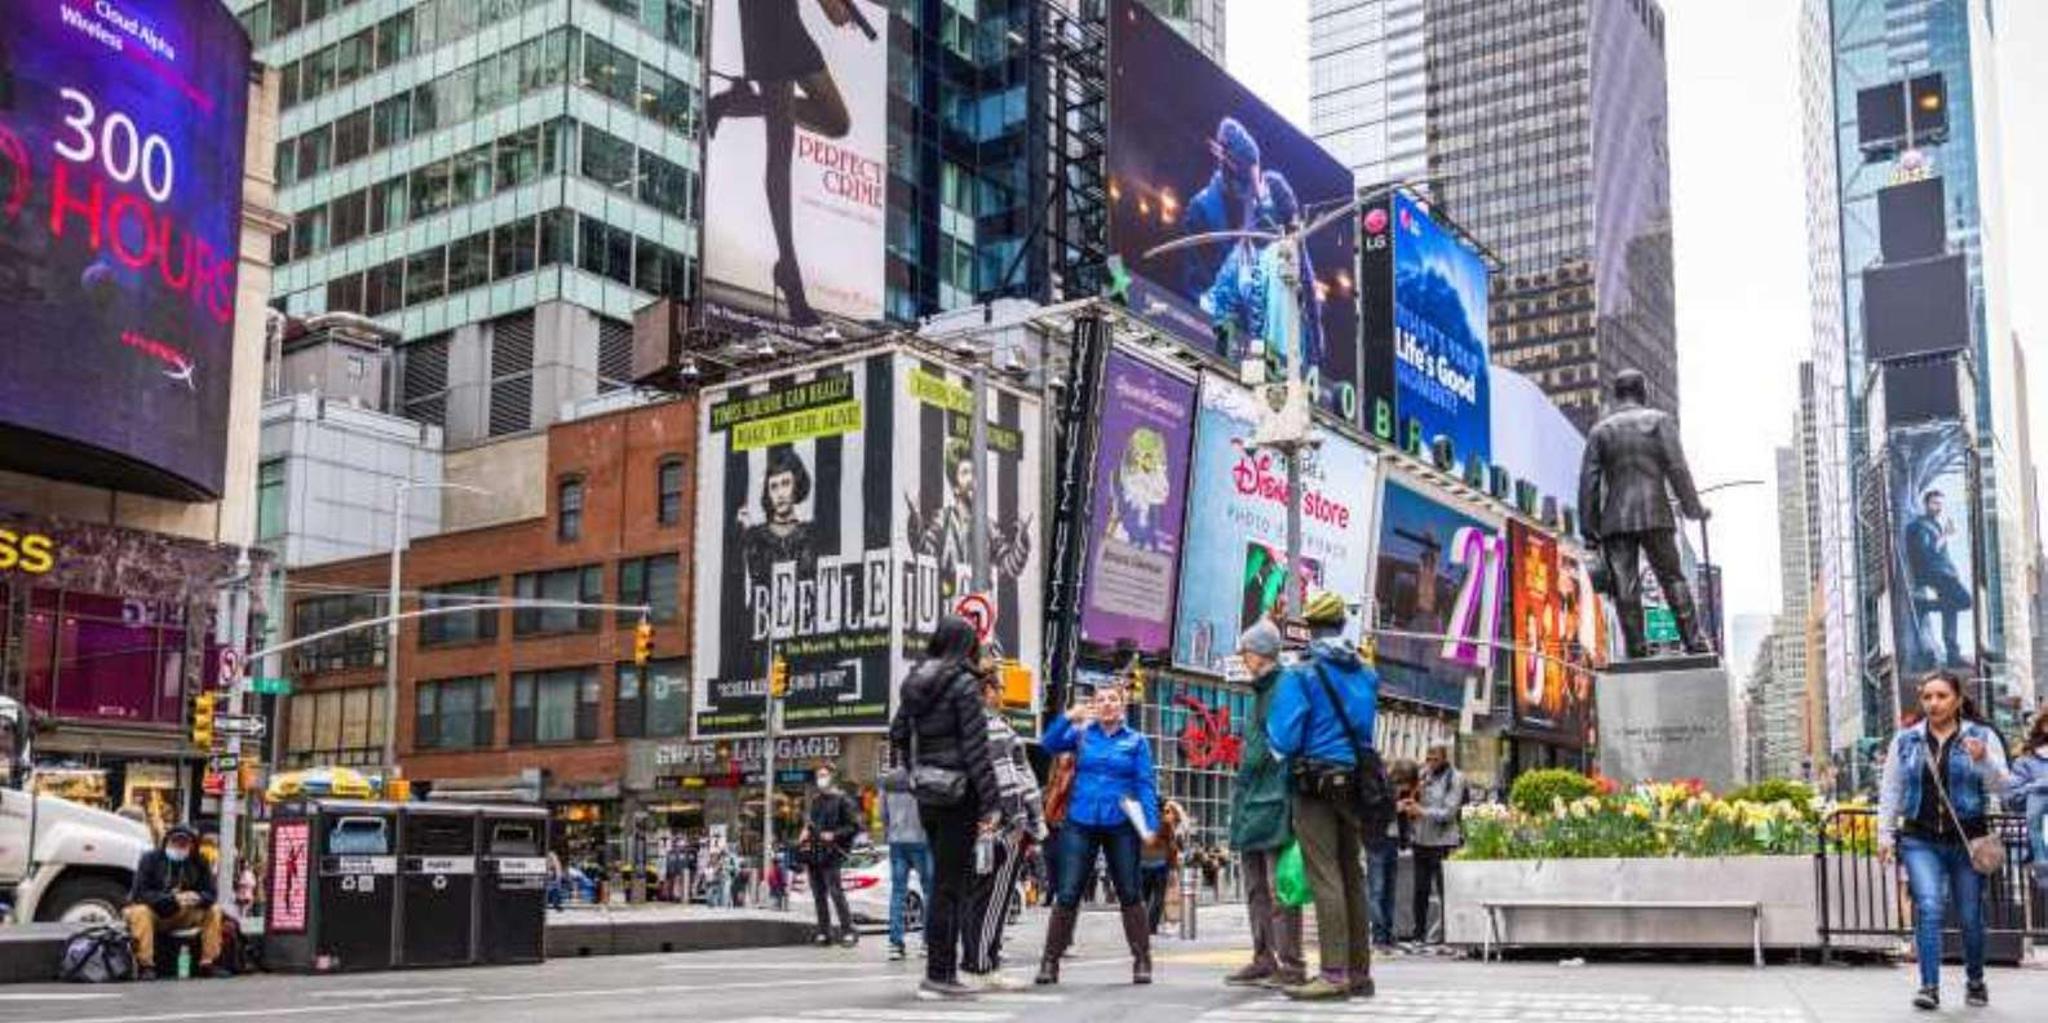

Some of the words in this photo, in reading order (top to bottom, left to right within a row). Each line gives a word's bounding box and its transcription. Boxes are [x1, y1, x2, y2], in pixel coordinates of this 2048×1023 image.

[60, 5, 123, 51] Wireless
[95, 0, 138, 36] Cloud
[138, 27, 175, 61] Alpha
[54, 88, 173, 202] 300
[798, 134, 882, 184] PERFECT
[823, 170, 882, 208] CRIME
[50, 162, 235, 325] HOURS
[1366, 235, 1386, 249] LG
[1395, 326, 1434, 377] Life's
[1436, 354, 1476, 404] Good
[808, 377, 849, 402] REALLY
[1303, 491, 1350, 529] store
[1441, 525, 1507, 669] 21
[655, 742, 716, 765] GIFTS
